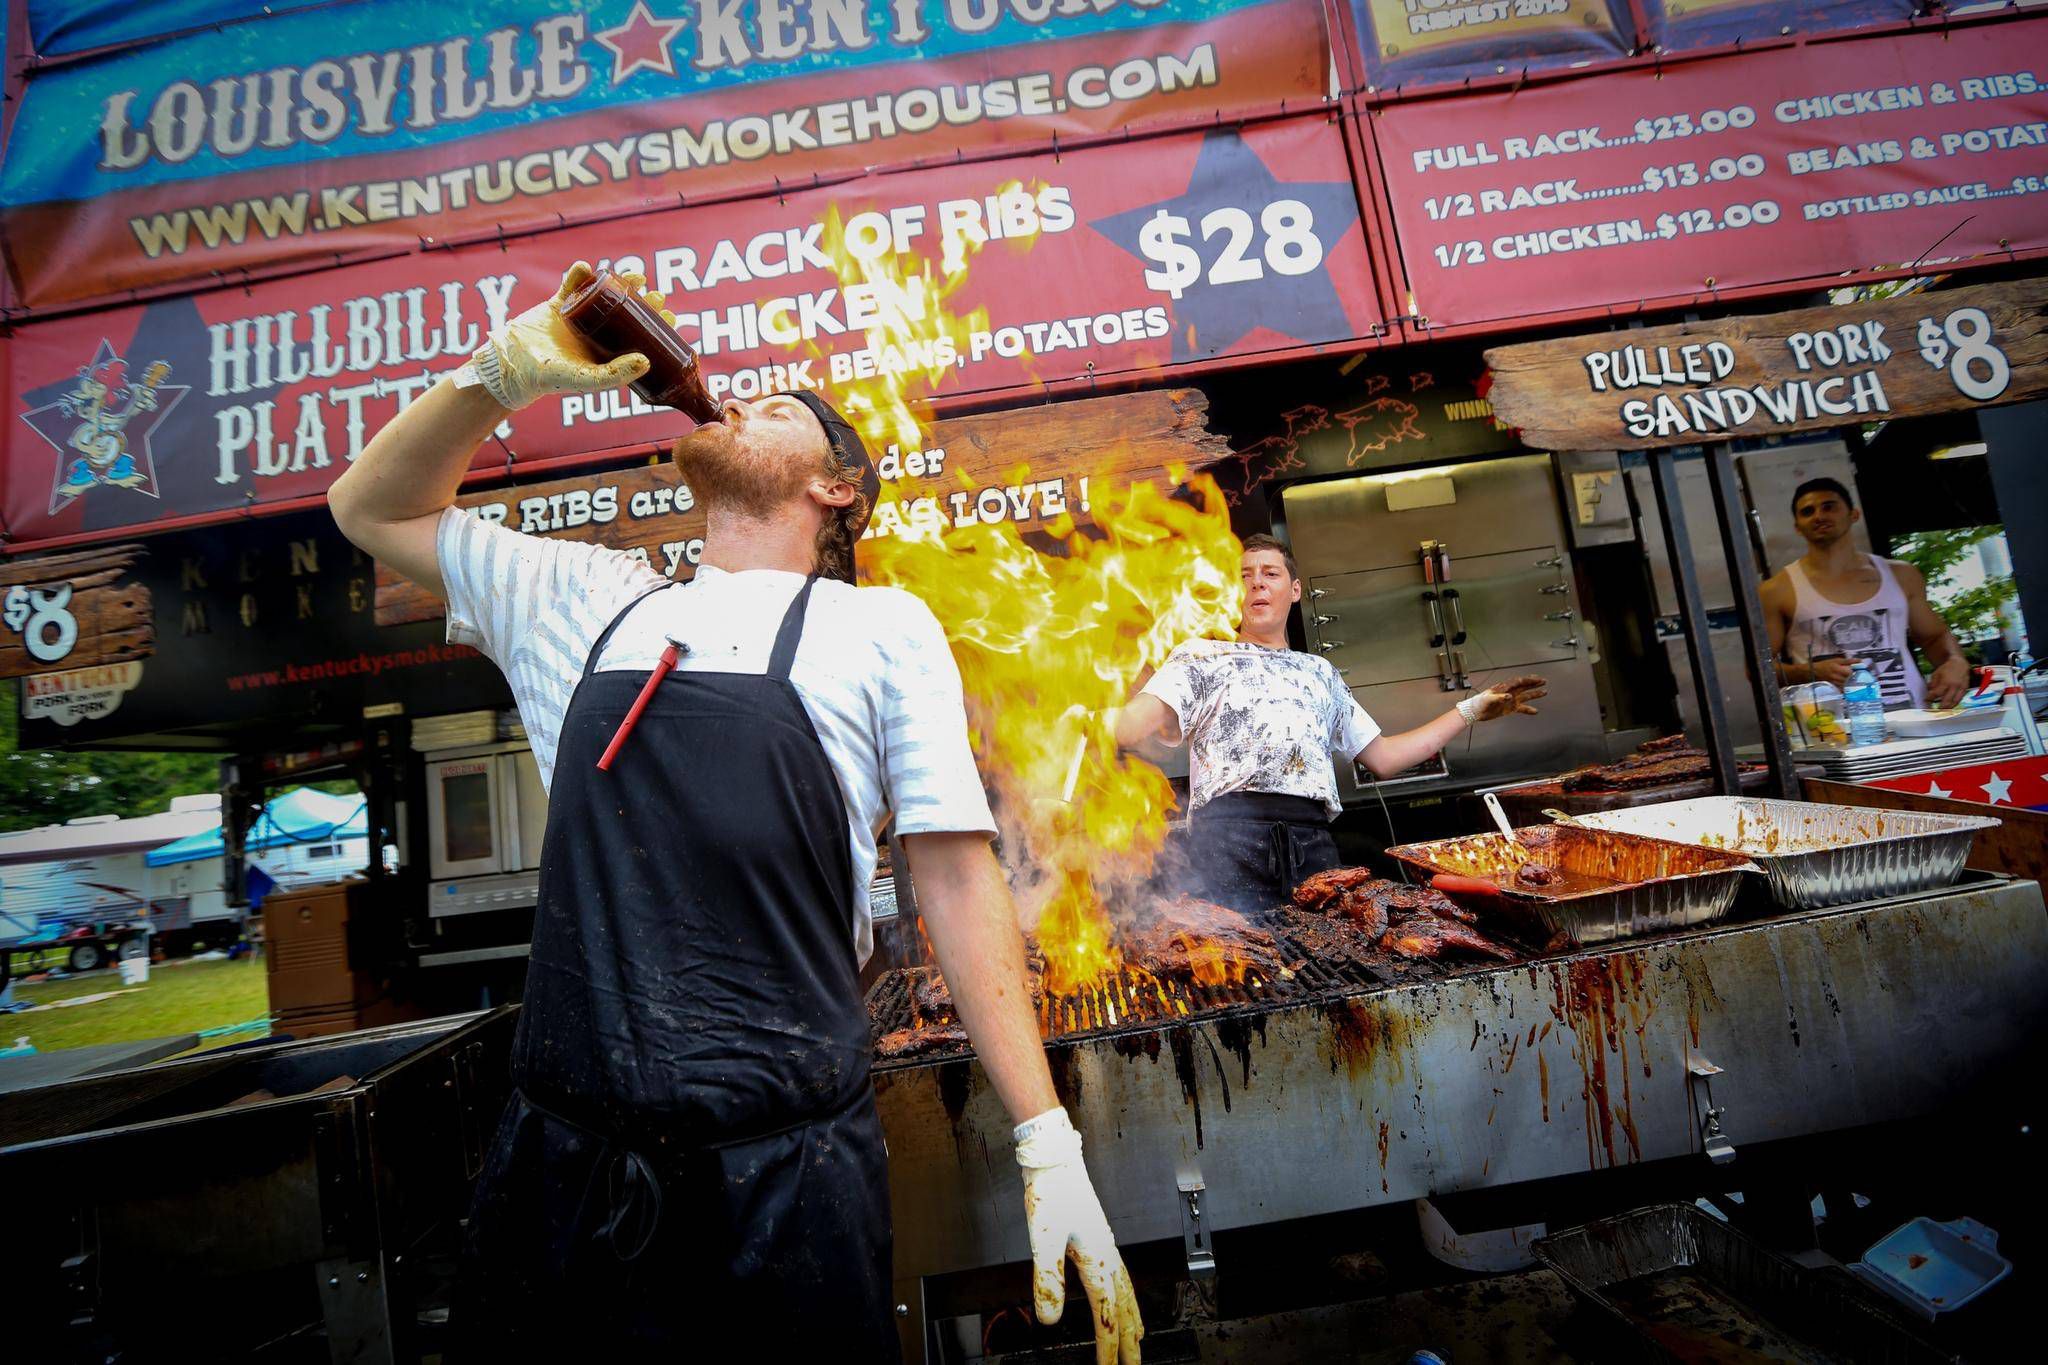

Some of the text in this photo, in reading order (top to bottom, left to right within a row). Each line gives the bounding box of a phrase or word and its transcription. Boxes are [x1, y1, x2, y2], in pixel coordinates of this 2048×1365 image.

[98, 13, 586, 169] LOUISVILLE
[1774, 86, 1924, 123] CHICKEN
[1930, 83, 1957, 104] &
[129, 43, 1218, 258] WWW.KENTUCKYSMOKEHOUSE.COM
[1413, 143, 1499, 173] FULL
[1787, 140, 1903, 176] BEANS
[1910, 137, 1938, 159] &
[655, 223, 834, 295] RACK
[843, 204, 926, 260] OF
[937, 186, 1076, 252] RIBS
[1138, 199, 1324, 300] $28
[1424, 194, 1475, 221] 1/2
[1803, 192, 1910, 222] BOTTLED
[1435, 240, 1487, 269] 1/2
[206, 273, 519, 397] HILLBILLY
[561, 306, 1170, 427] PULL PORK, BEANS, POTATOES
[1585, 320, 1893, 392] PULLED PORK
[1917, 307, 2010, 400] $8
[214, 369, 514, 485] PLATT
[1622, 370, 1890, 437] SANDWICH
[519, 485, 619, 534] RIBS
[630, 484, 695, 517] are
[876, 443, 946, 481] der
[662, 538, 705, 577] yo
[861, 494, 940, 539] A'S
[950, 477, 1067, 529] LOVE
[3, 582, 79, 662] $8
